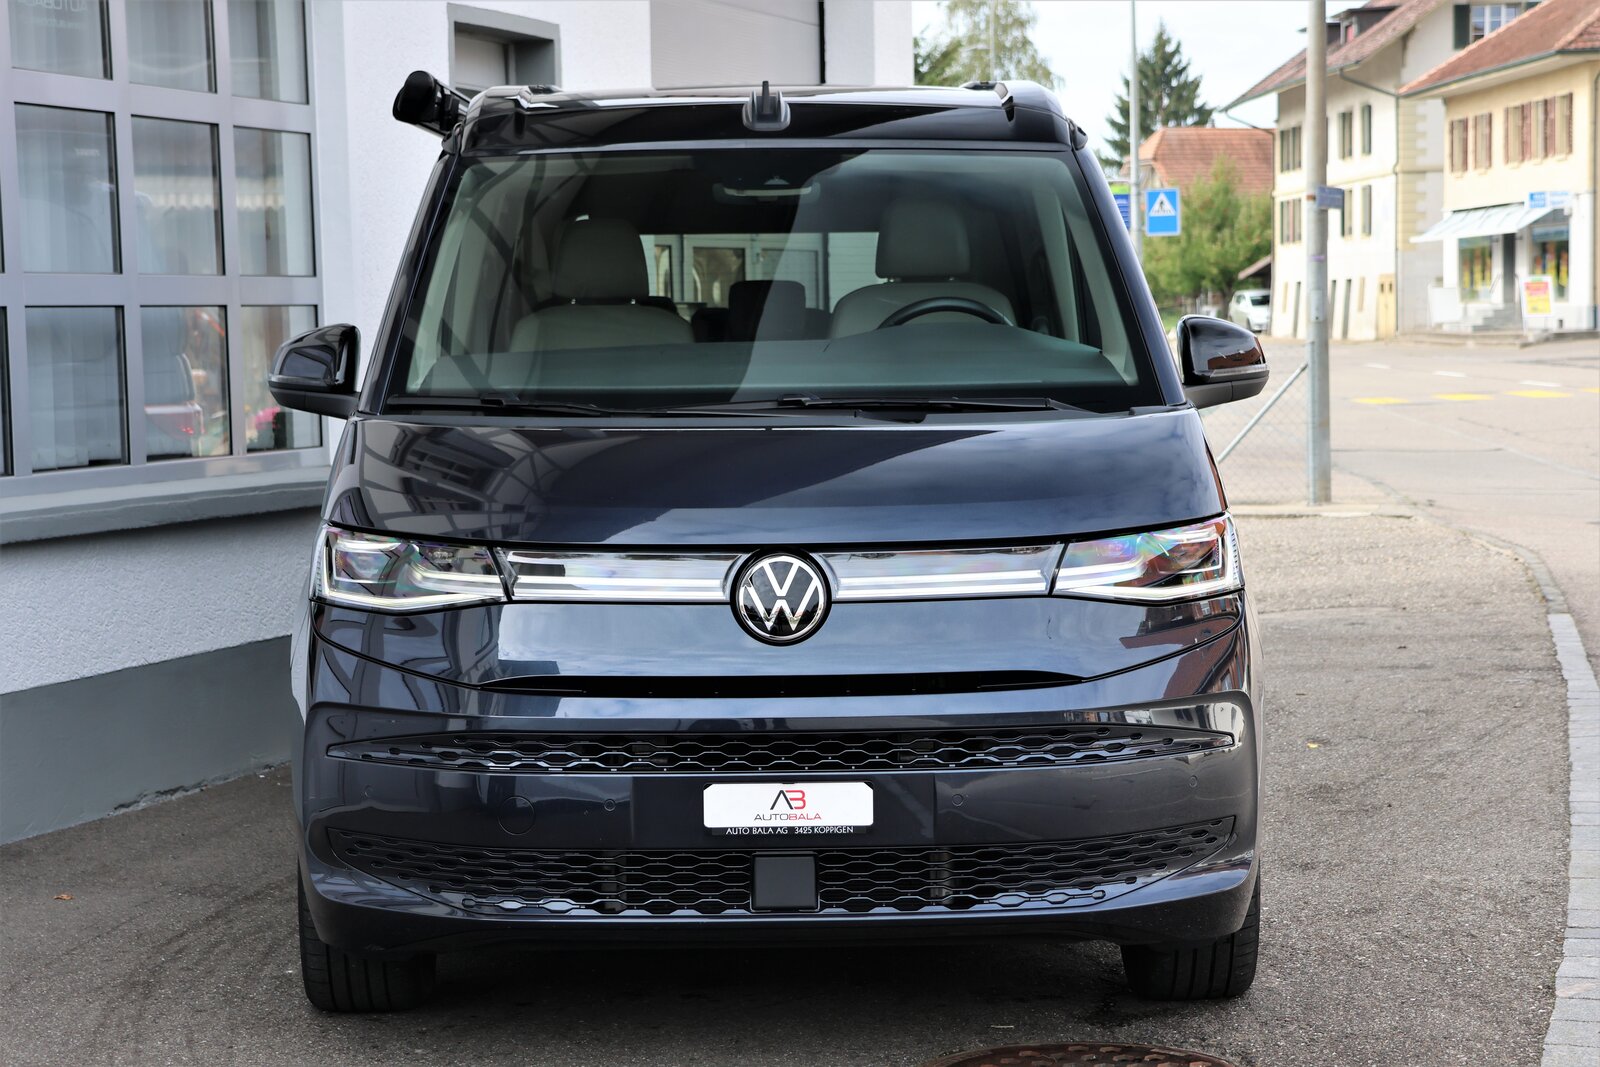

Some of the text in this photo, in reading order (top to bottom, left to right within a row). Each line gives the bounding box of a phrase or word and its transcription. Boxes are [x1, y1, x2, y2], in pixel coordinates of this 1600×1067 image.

[740, 557, 823, 635] VW
[754, 813, 822, 821] AUTOBALA
[726, 827, 750, 835] AUTO
[752, 827, 774, 835] BALA
[794, 826, 812, 834] 3425
[814, 826, 854, 834] KOPPIGEN
